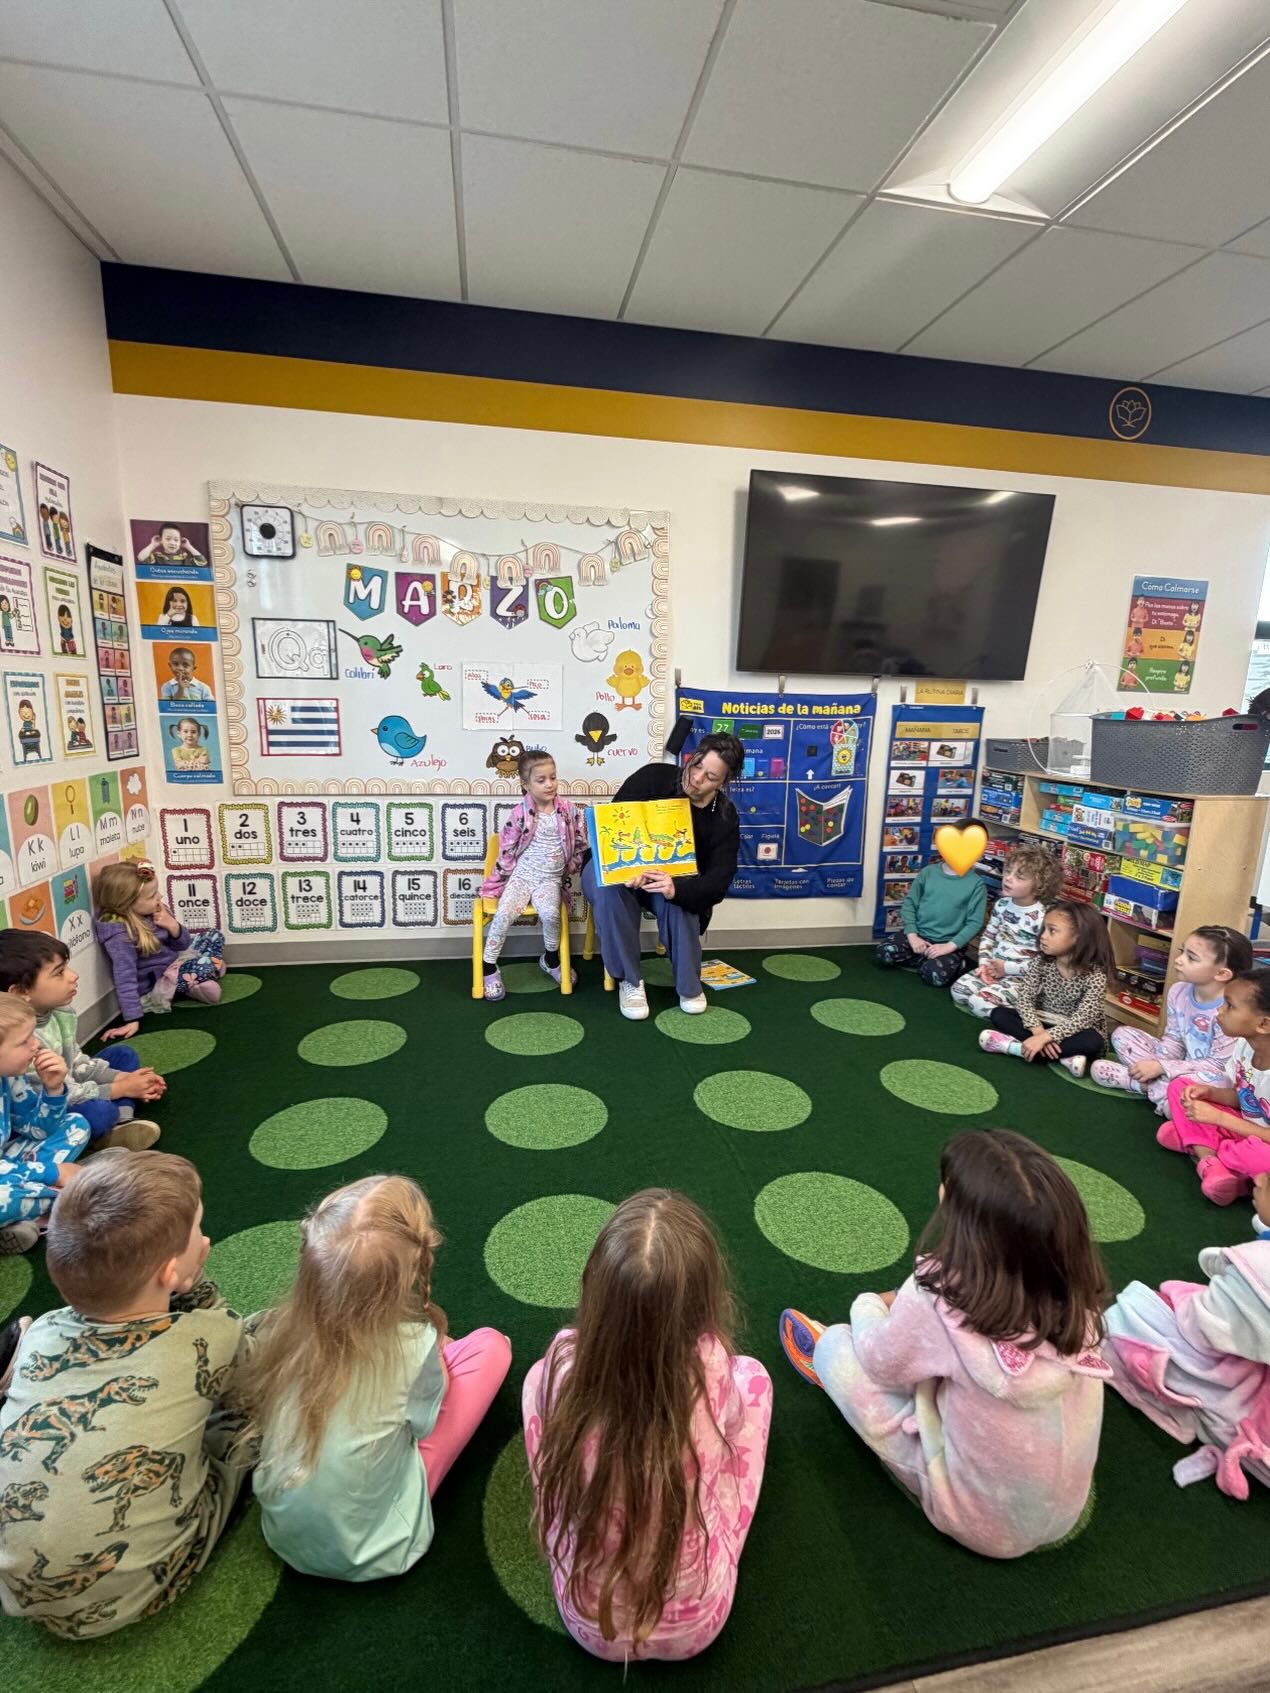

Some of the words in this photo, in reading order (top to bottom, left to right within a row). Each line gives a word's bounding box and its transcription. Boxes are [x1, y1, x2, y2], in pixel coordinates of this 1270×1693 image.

[1164, 583, 1200, 594] Calmarse
[348, 574, 570, 620] MARZO
[607, 617, 641, 630] Paloma
[721, 702, 775, 715] Noticias
[777, 703, 794, 714] de
[797, 704, 809, 715] la
[812, 703, 862, 715] mañana
[716, 723, 729, 733] 27
[239, 813, 250, 828] 2
[296, 811, 307, 825] 3
[350, 812, 361, 826] 4
[404, 812, 414, 826] 5
[459, 812, 469, 826] 6
[183, 818, 189, 832] 1
[234, 829, 258, 840] dos
[288, 826, 317, 838] tres
[339, 827, 374, 837] cuatro
[394, 827, 427, 838] cinco
[452, 827, 476, 838] seis
[27, 840, 35, 856] K
[37, 837, 45, 853] k
[175, 836, 200, 845] uno
[68, 845, 85, 859] lupa
[30, 857, 47, 873] kiwi
[188, 883, 196, 897] 11
[242, 881, 257, 896] 12
[298, 879, 313, 893] 13
[353, 879, 368, 893] 14
[407, 878, 421, 891] 15
[458, 878, 472, 891] 16
[178, 898, 210, 908] once
[235, 896, 268, 908] doce
[290, 893, 324, 904] trece
[343, 893, 379, 902] catorce
[398, 893, 432, 904] quince
[68, 917, 76, 930] X
